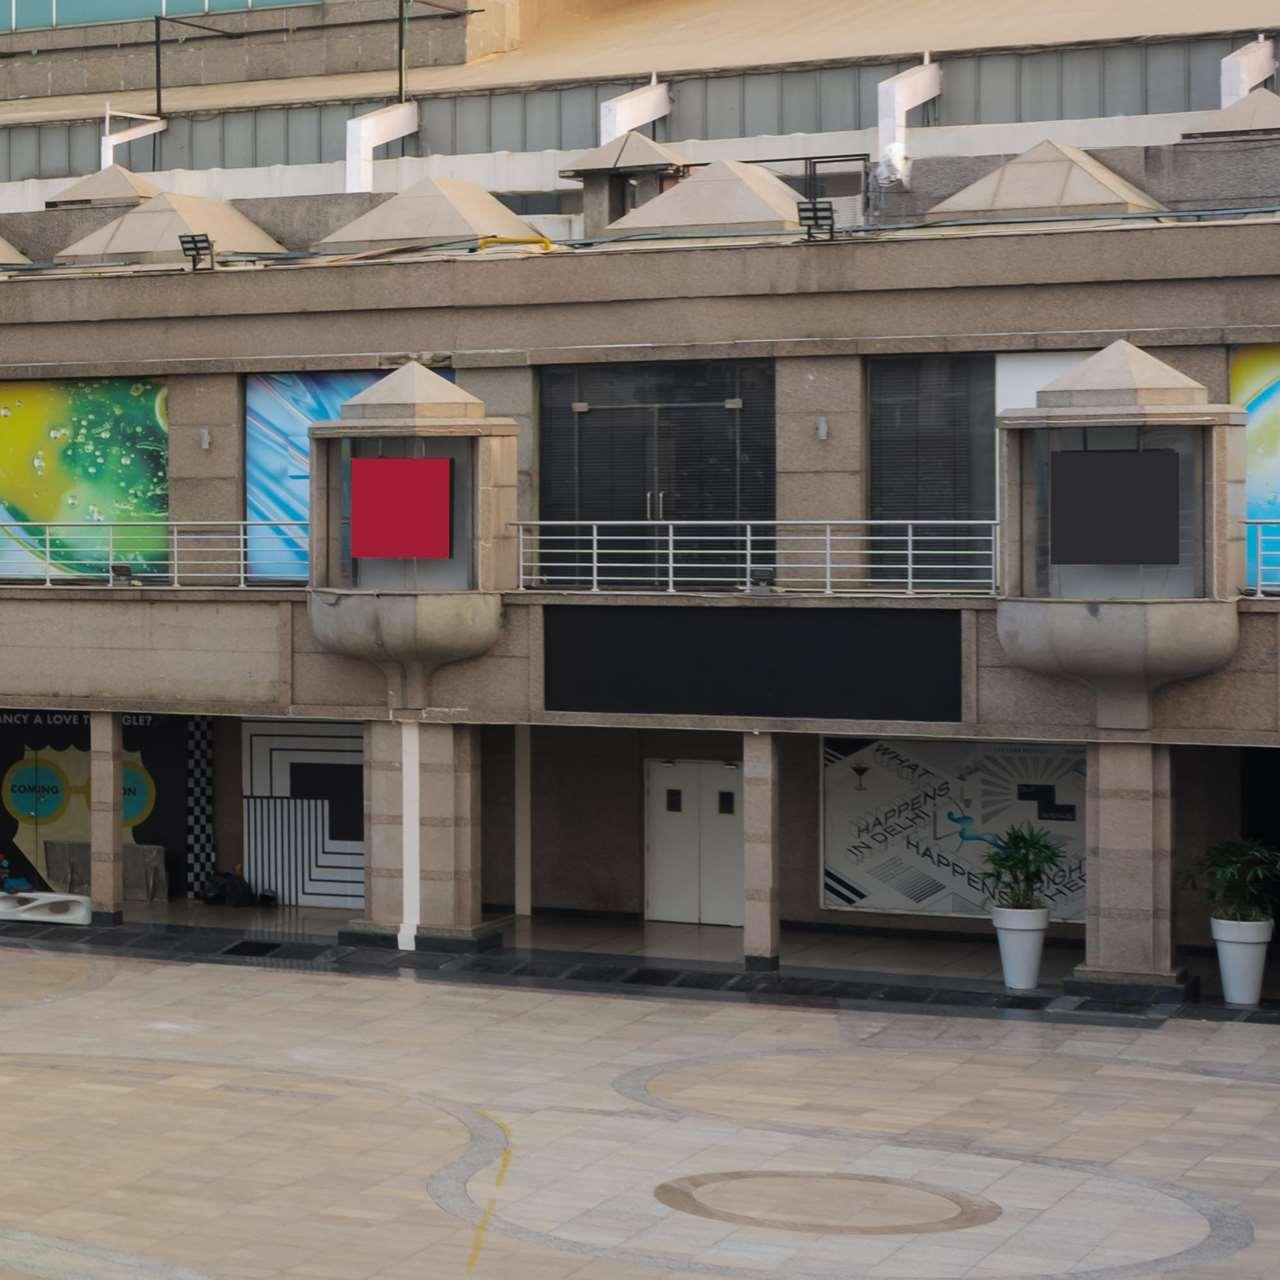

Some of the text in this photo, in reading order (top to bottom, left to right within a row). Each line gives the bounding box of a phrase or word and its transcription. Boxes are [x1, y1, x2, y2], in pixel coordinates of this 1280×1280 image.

[33, 714, 44, 725] A
[47, 714, 80, 726] LOVE
[875, 743, 936, 779] WHAT
[857, 781, 951, 840] HAPPENS
[846, 808, 931, 857] IN DELHI
[906, 834, 1009, 905] HAPPENS
[1032, 858, 1086, 896] RIGH
